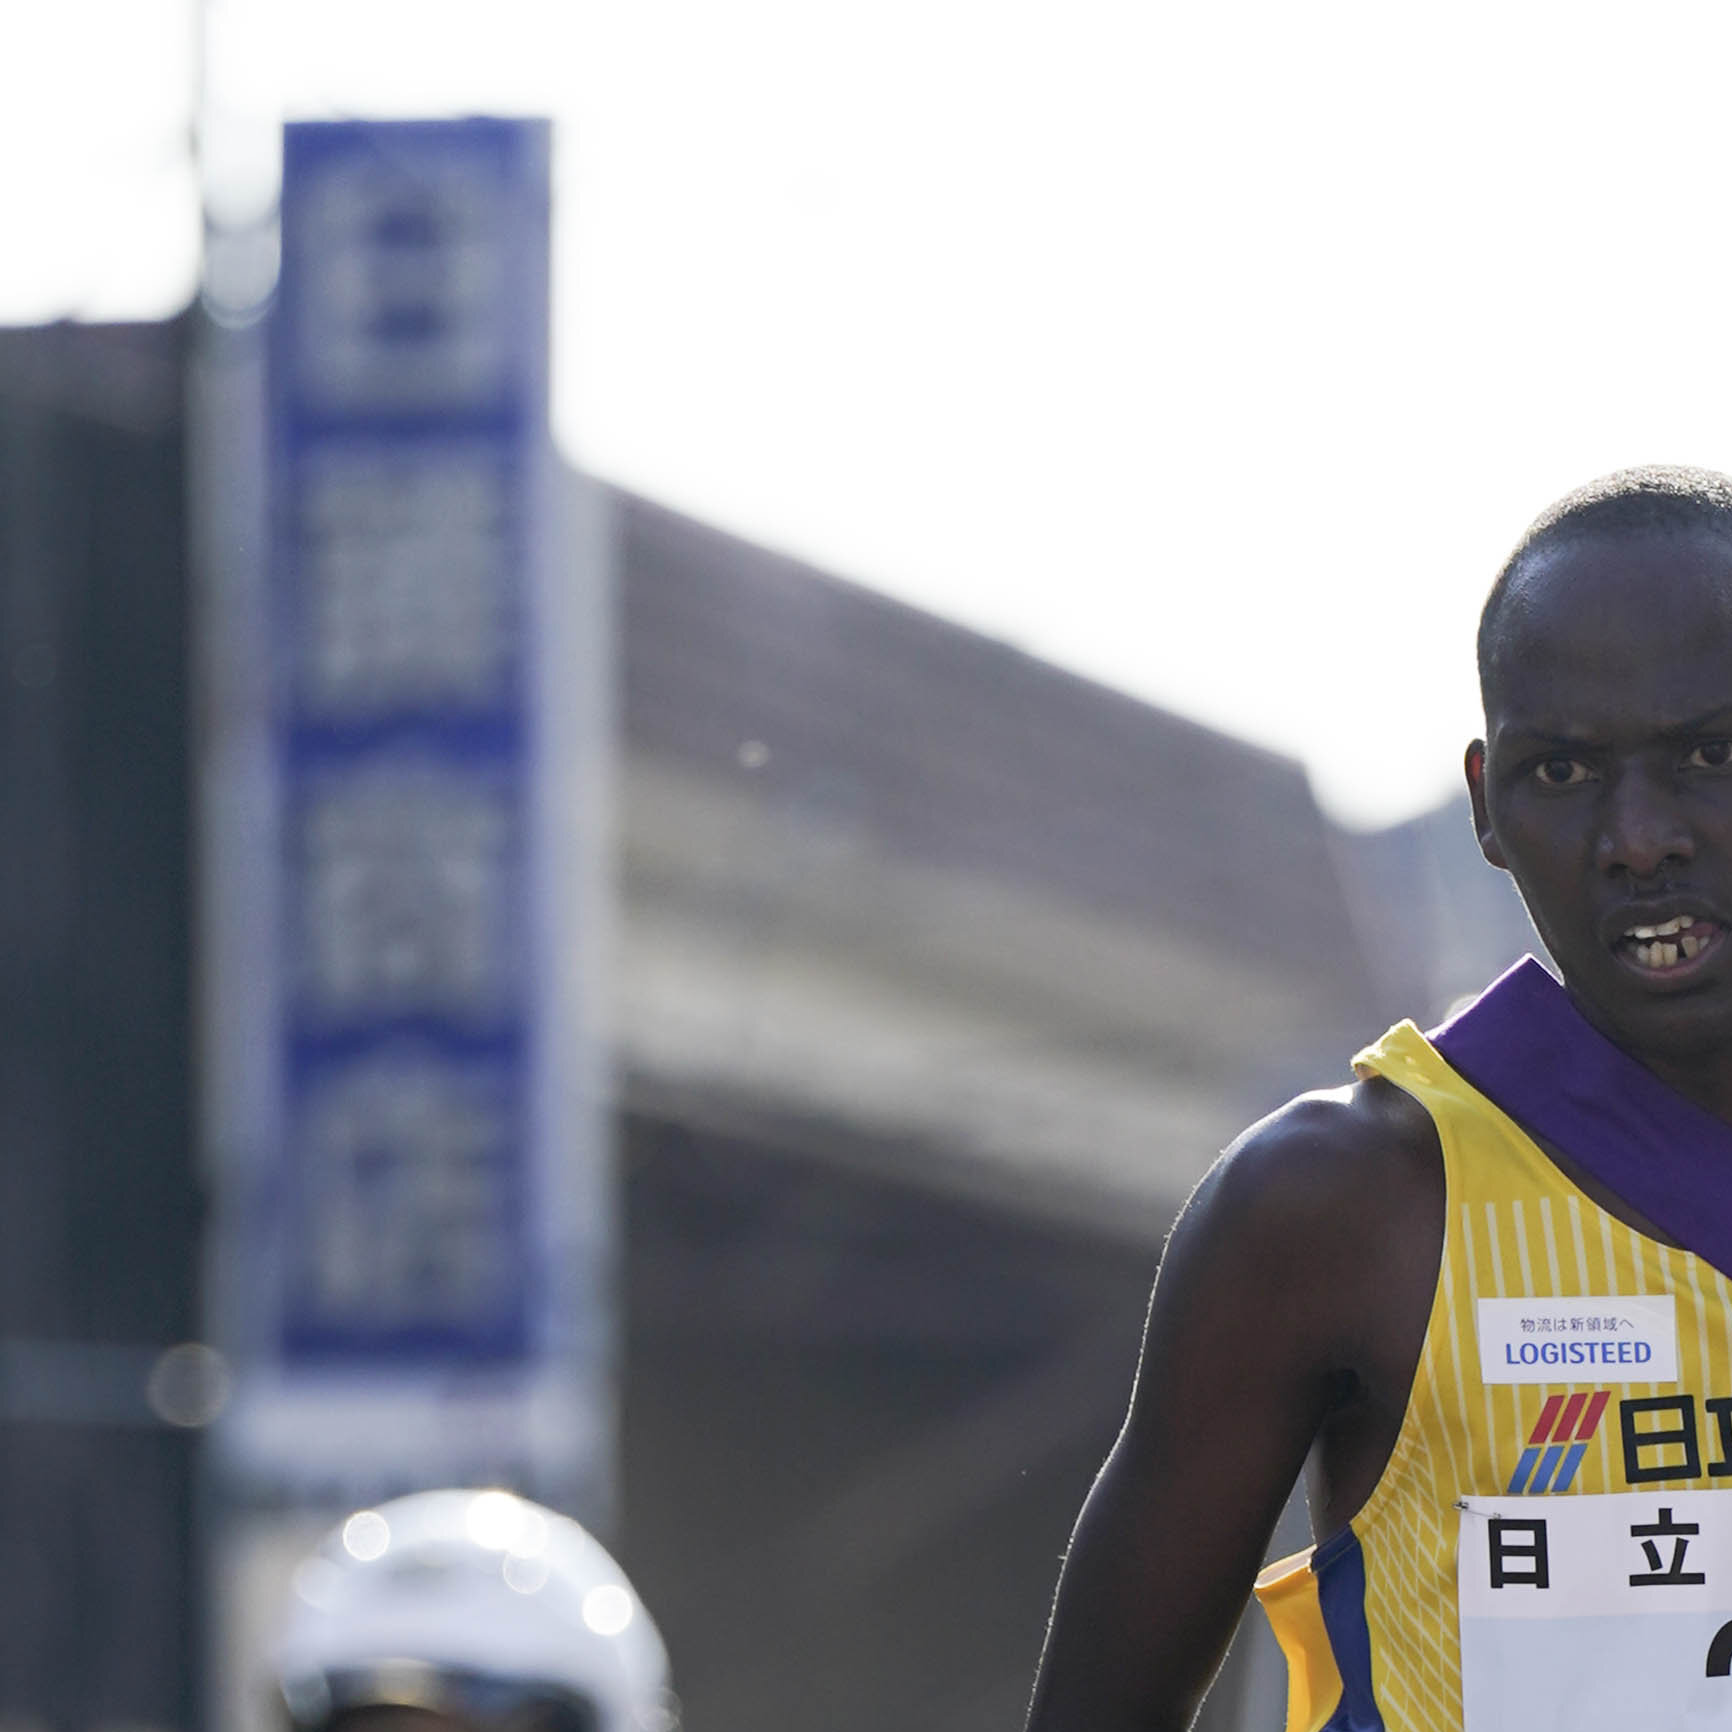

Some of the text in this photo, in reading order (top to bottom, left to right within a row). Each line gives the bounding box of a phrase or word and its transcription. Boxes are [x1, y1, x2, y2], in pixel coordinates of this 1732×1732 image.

[1519, 1315, 1635, 1334] 物流は新領域へ
[1505, 1341, 1652, 1366] LOGISTEED
